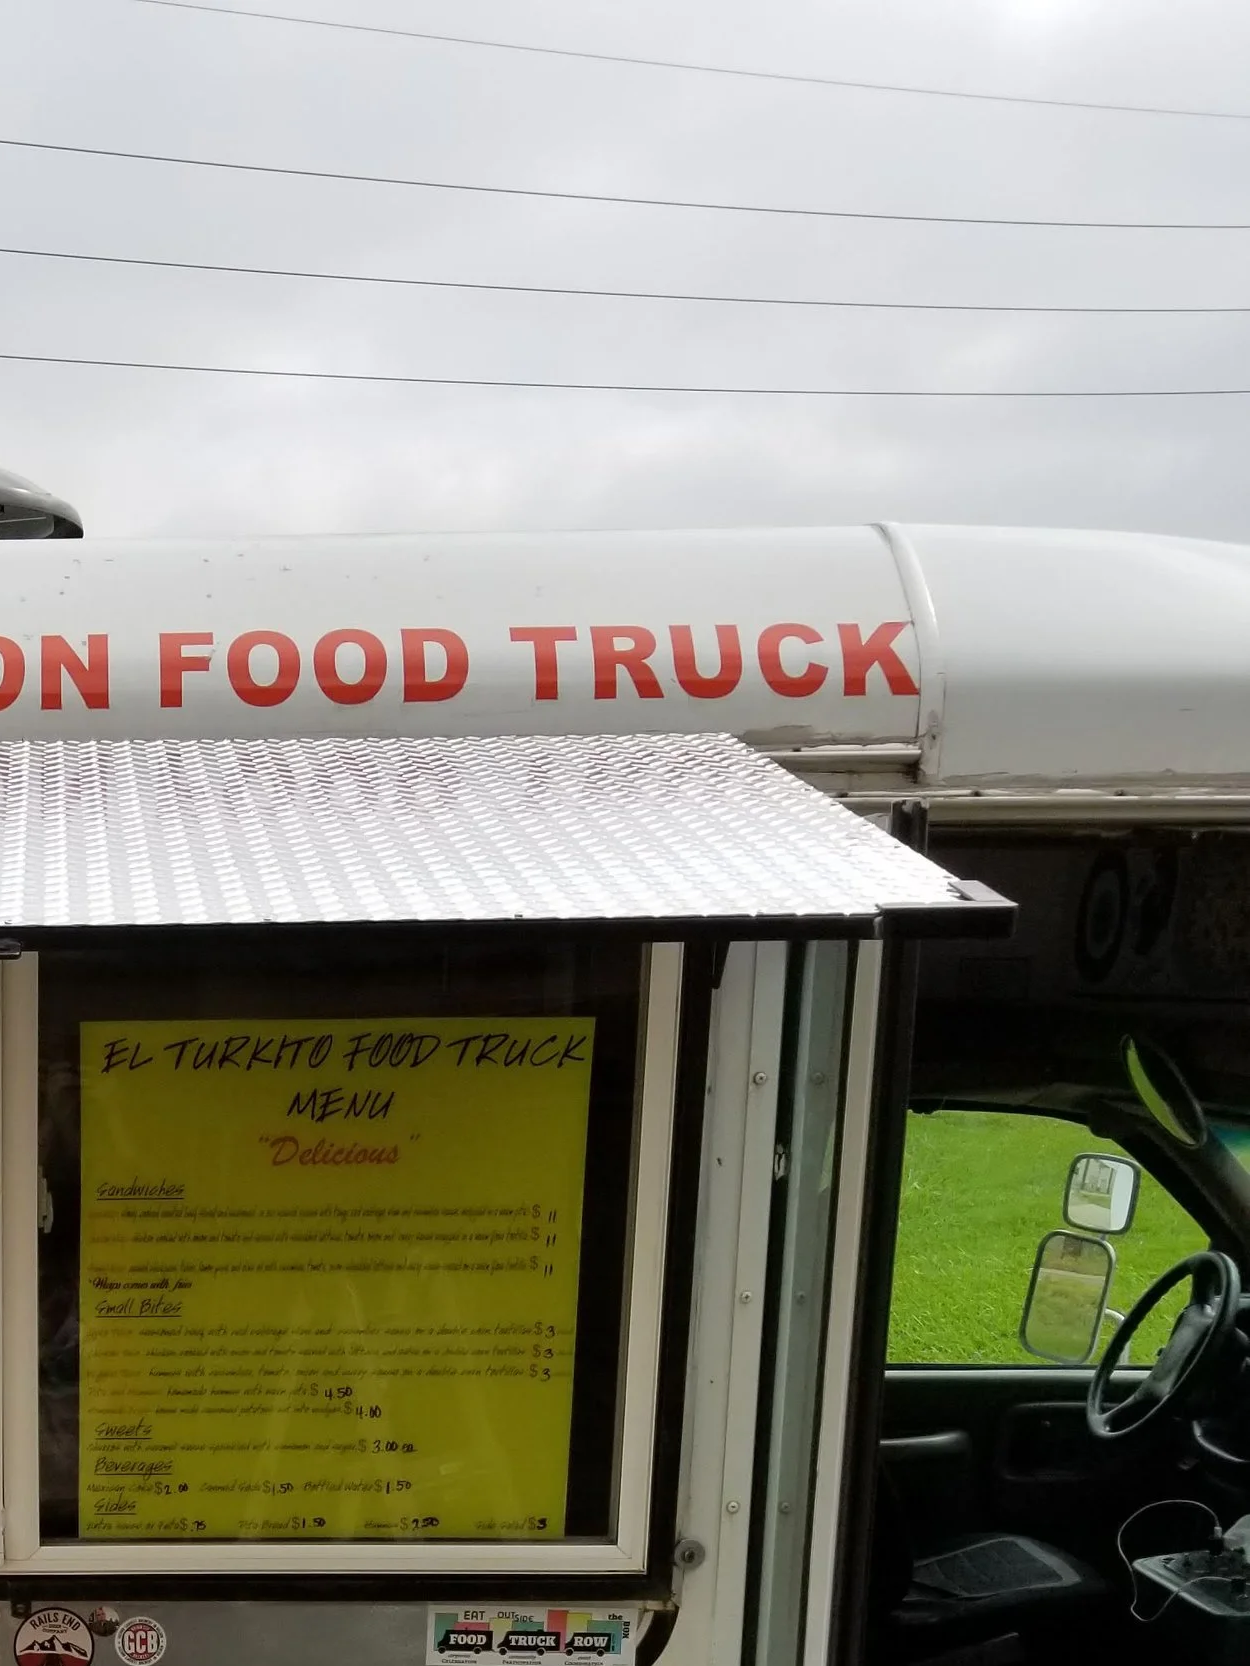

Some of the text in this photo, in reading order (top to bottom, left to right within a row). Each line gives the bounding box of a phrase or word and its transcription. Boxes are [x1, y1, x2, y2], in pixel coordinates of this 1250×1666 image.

[158, 627, 470, 710] FOOD
[510, 620, 922, 703] TRUCK
[101, 1032, 588, 1074] EL TURKITO FOOD TRUCK
[286, 1088, 395, 1124] MENU
[96, 1176, 186, 1199] Sandwiches
[122, 1280, 149, 1290] comes
[149, 1278, 170, 1290] with
[95, 1293, 183, 1316] Small Bites
[94, 1416, 153, 1439] Sweets
[93, 1456, 173, 1481] Beverages
[94, 1491, 137, 1514] Sides
[29, 1612, 82, 1632] RAILS END
[463, 1610, 486, 1621] EAT
[123, 1630, 158, 1654] GCB
[448, 1633, 610, 1649] FOOD TRUCK ROW
[621, 1621, 631, 1640] BOX
